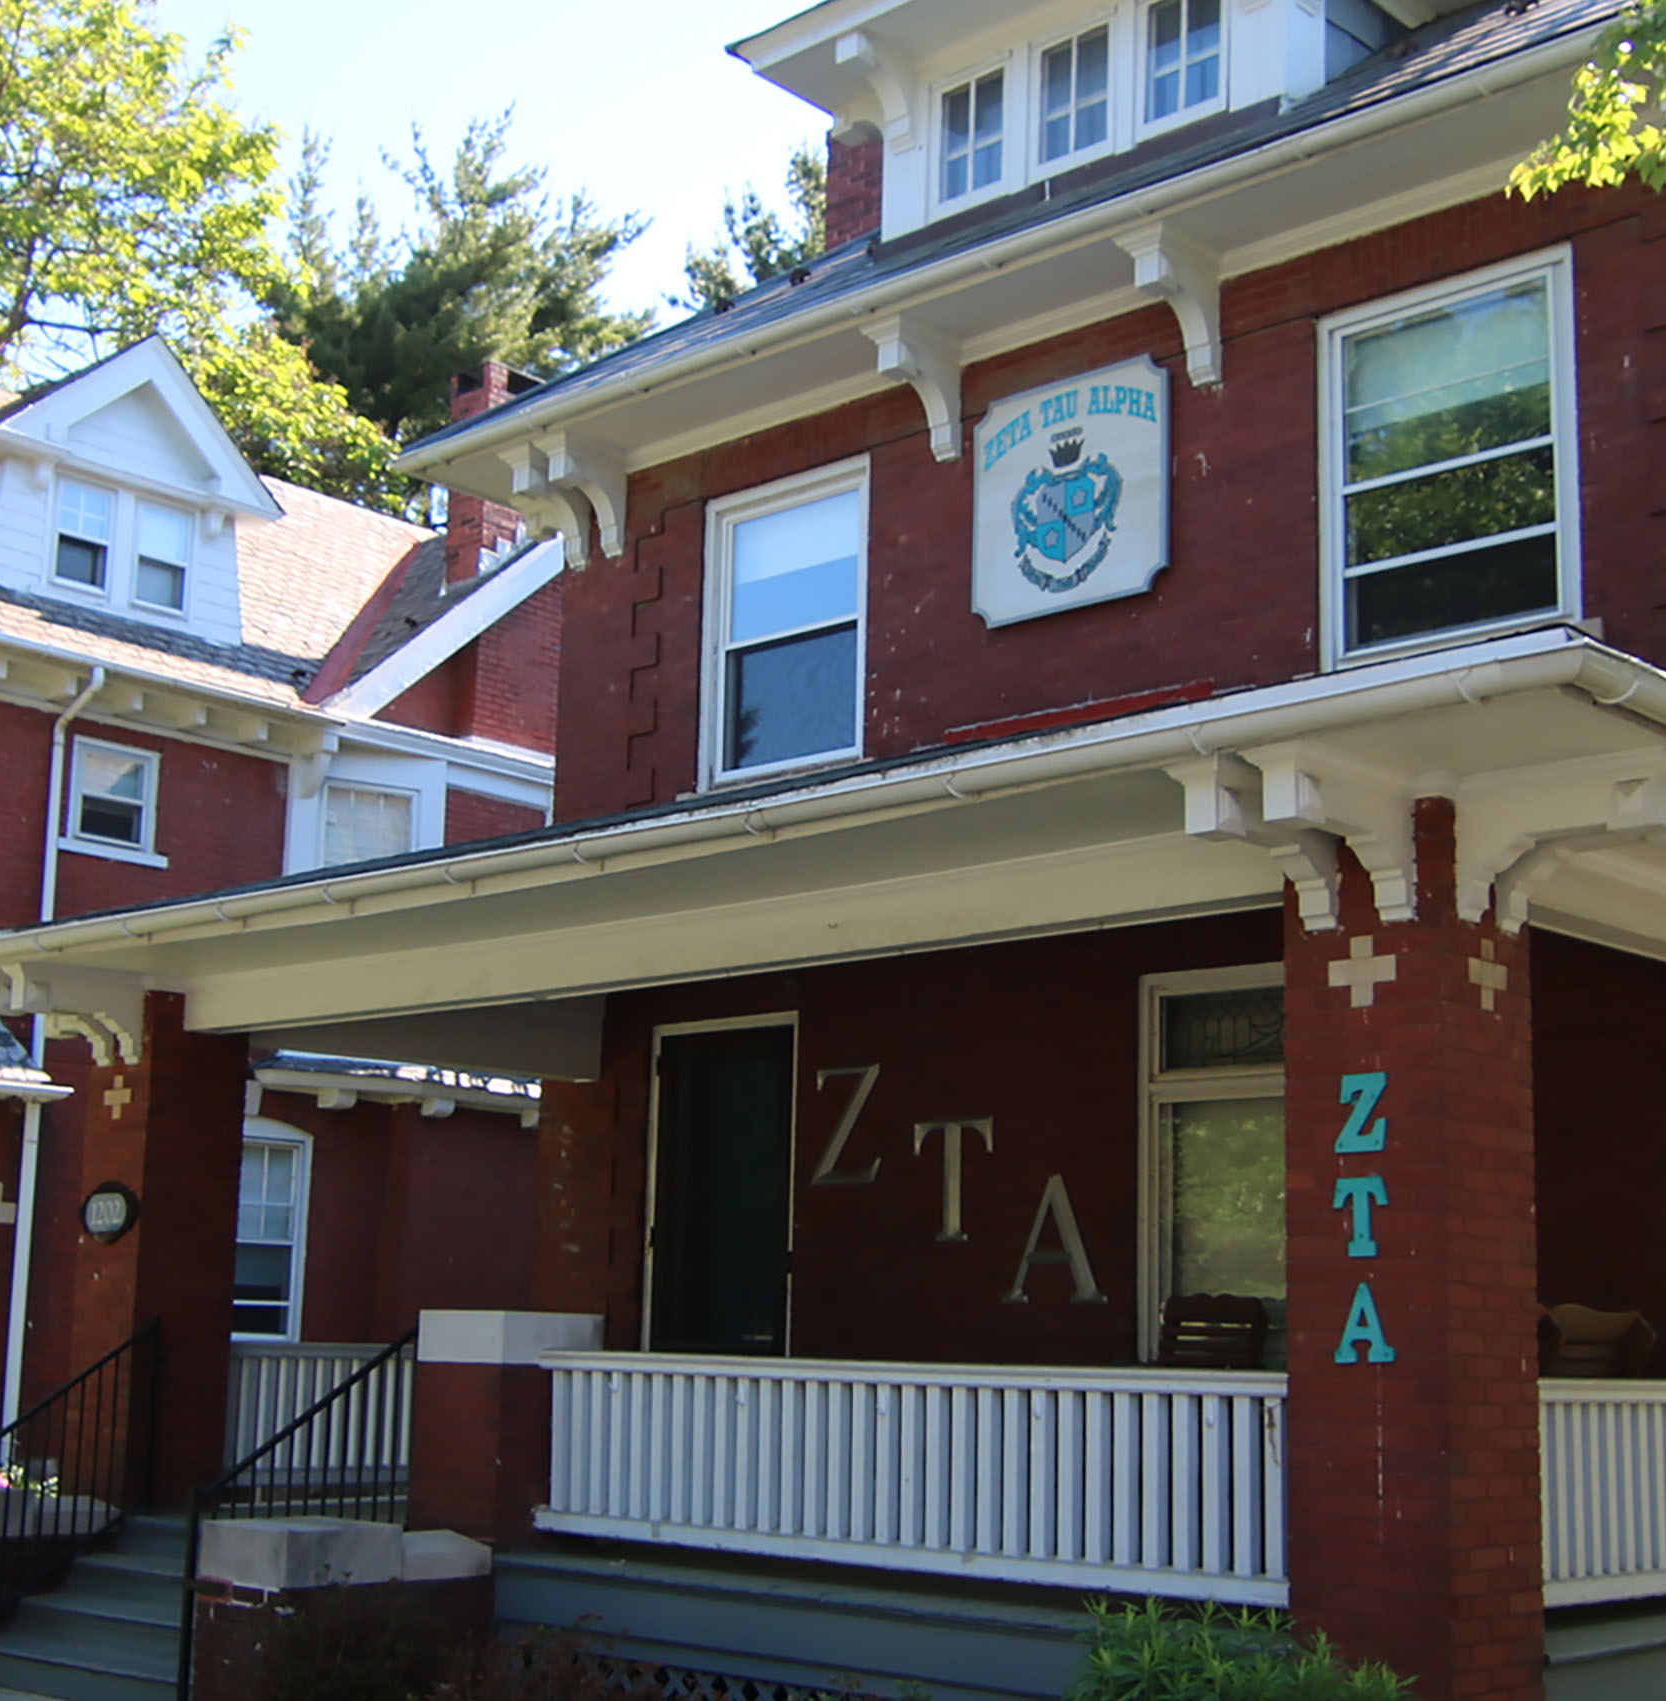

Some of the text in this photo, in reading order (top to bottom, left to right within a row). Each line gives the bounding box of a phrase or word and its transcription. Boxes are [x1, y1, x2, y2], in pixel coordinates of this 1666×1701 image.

[984, 385, 1158, 472] ZETA TAU ALPHA
